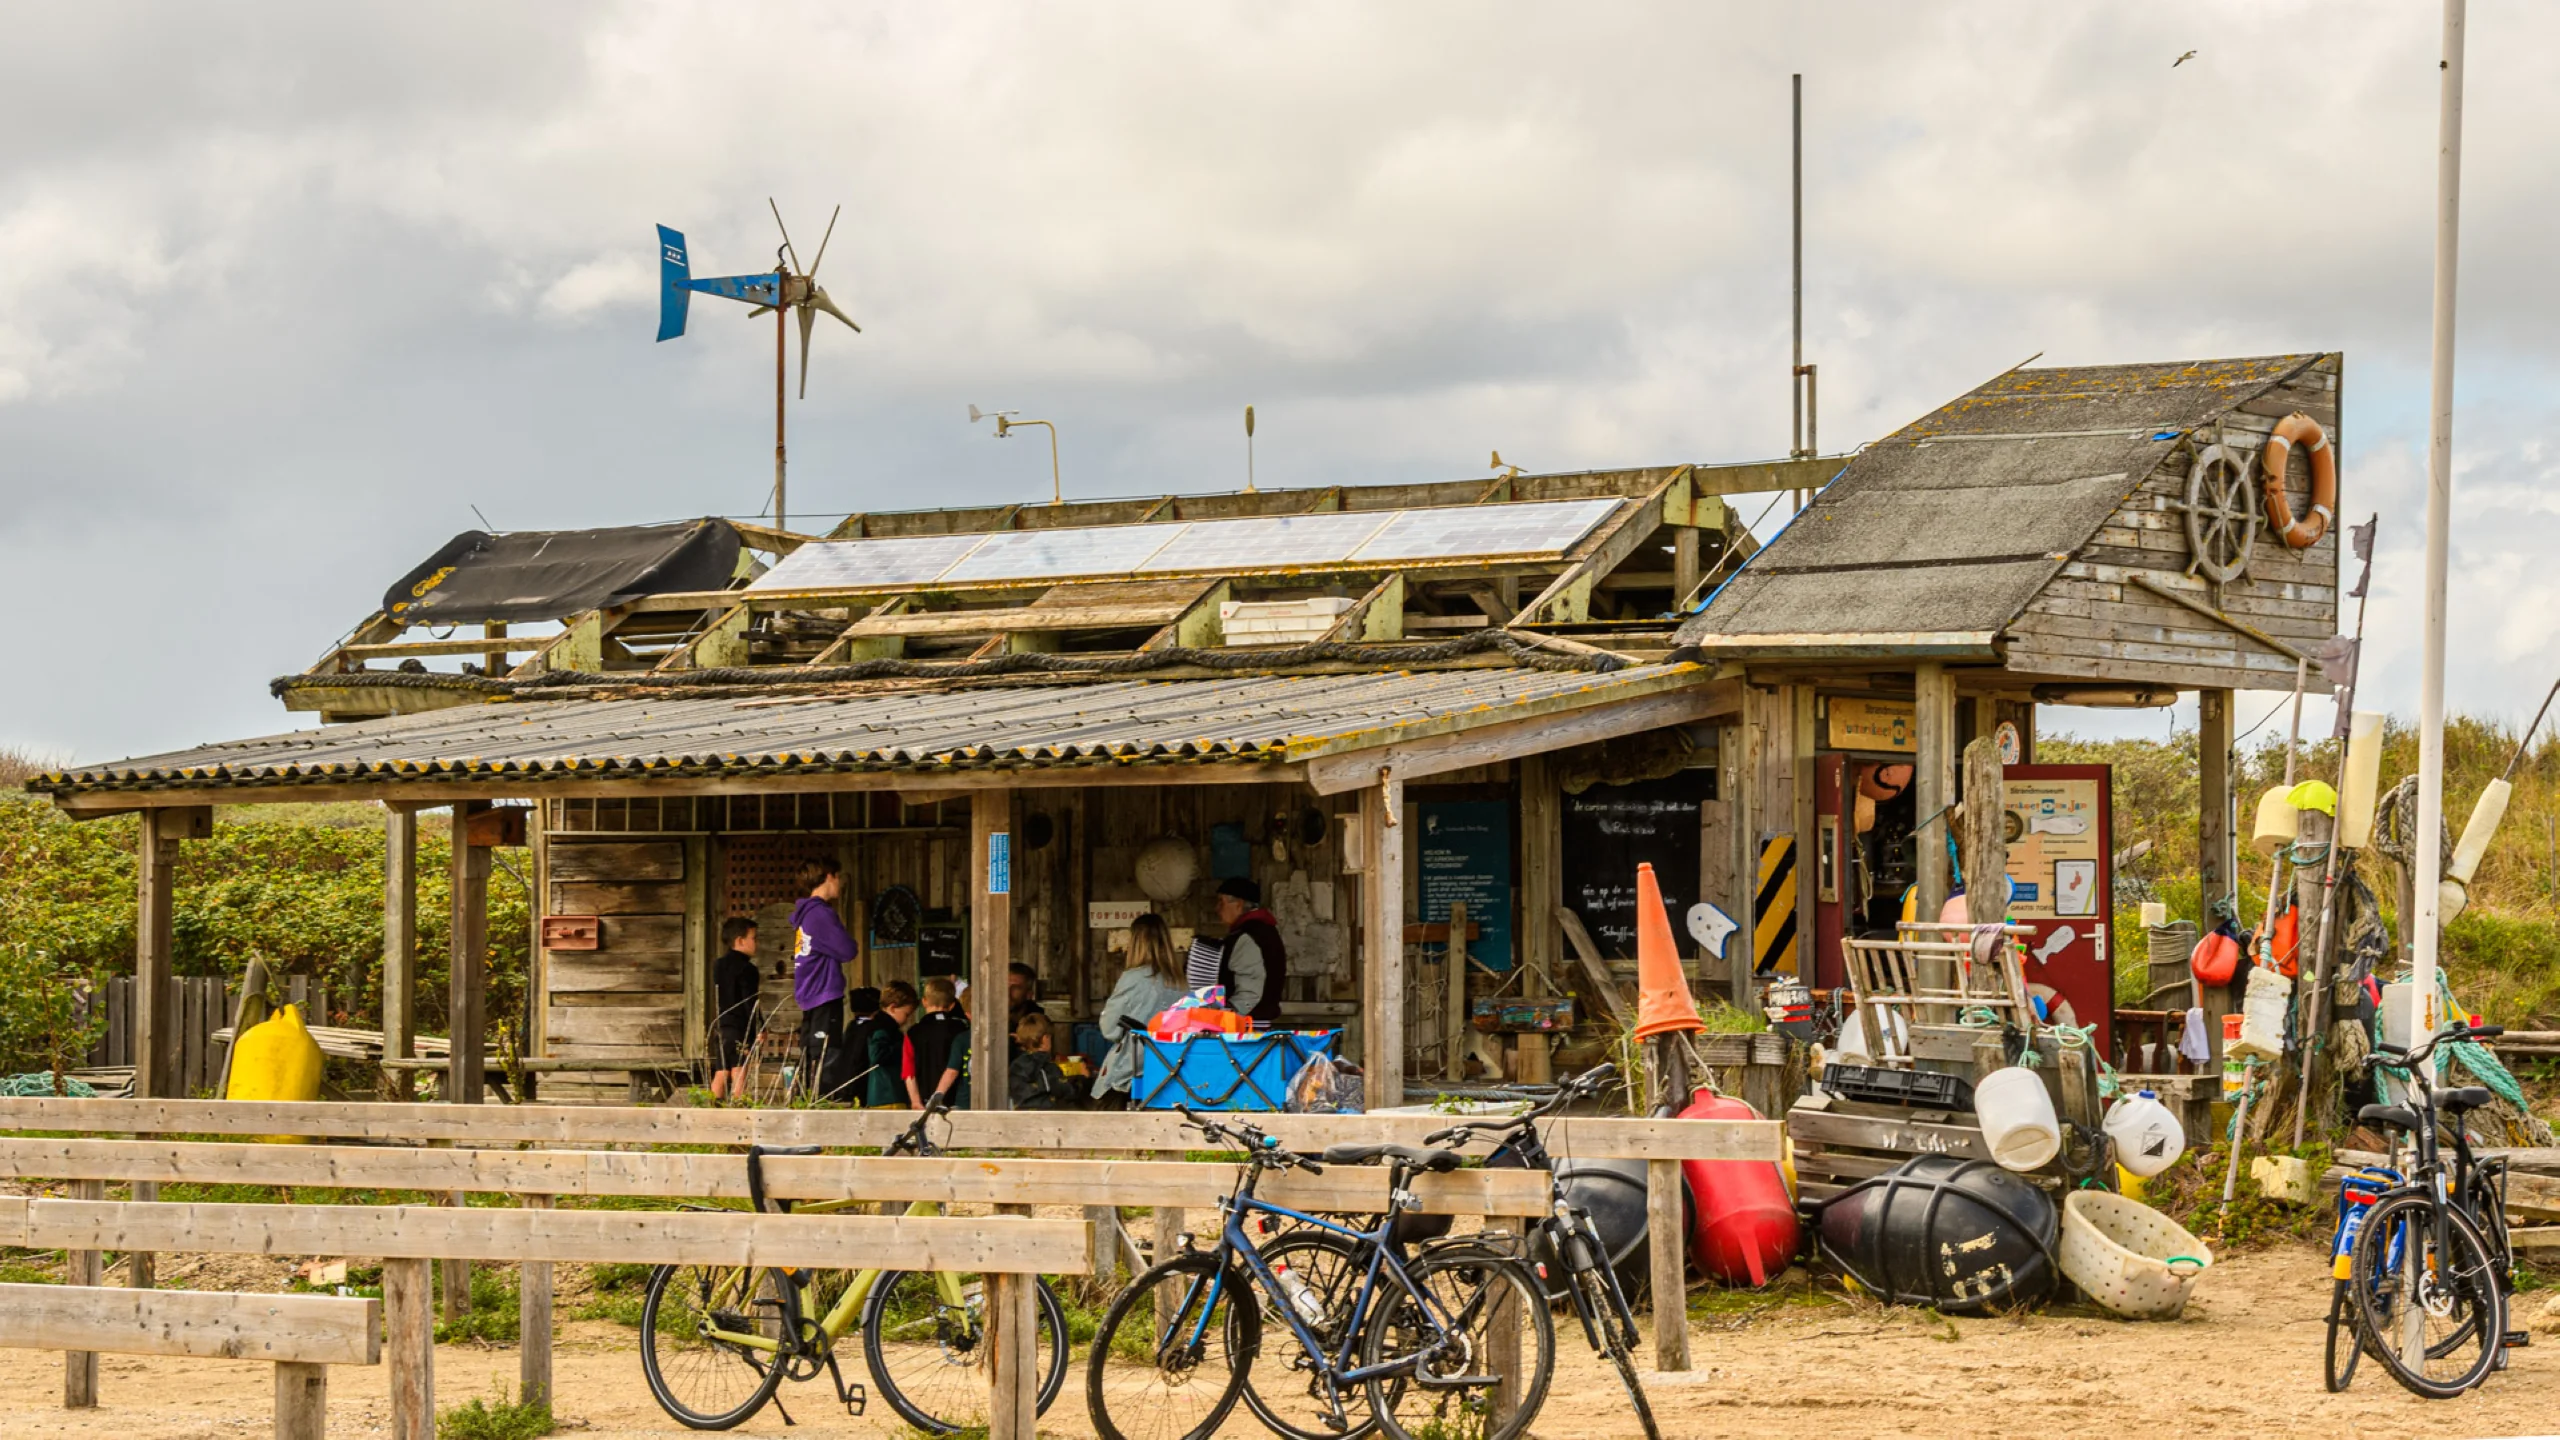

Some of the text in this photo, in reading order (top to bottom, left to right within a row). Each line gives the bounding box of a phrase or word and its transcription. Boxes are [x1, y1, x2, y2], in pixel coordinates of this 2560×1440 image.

[2010, 786, 2065, 795] Strandmuseum
[1599, 887, 1609, 898] op
[1612, 884, 1621, 894] de
[2010, 904, 2034, 912] GRATIS
